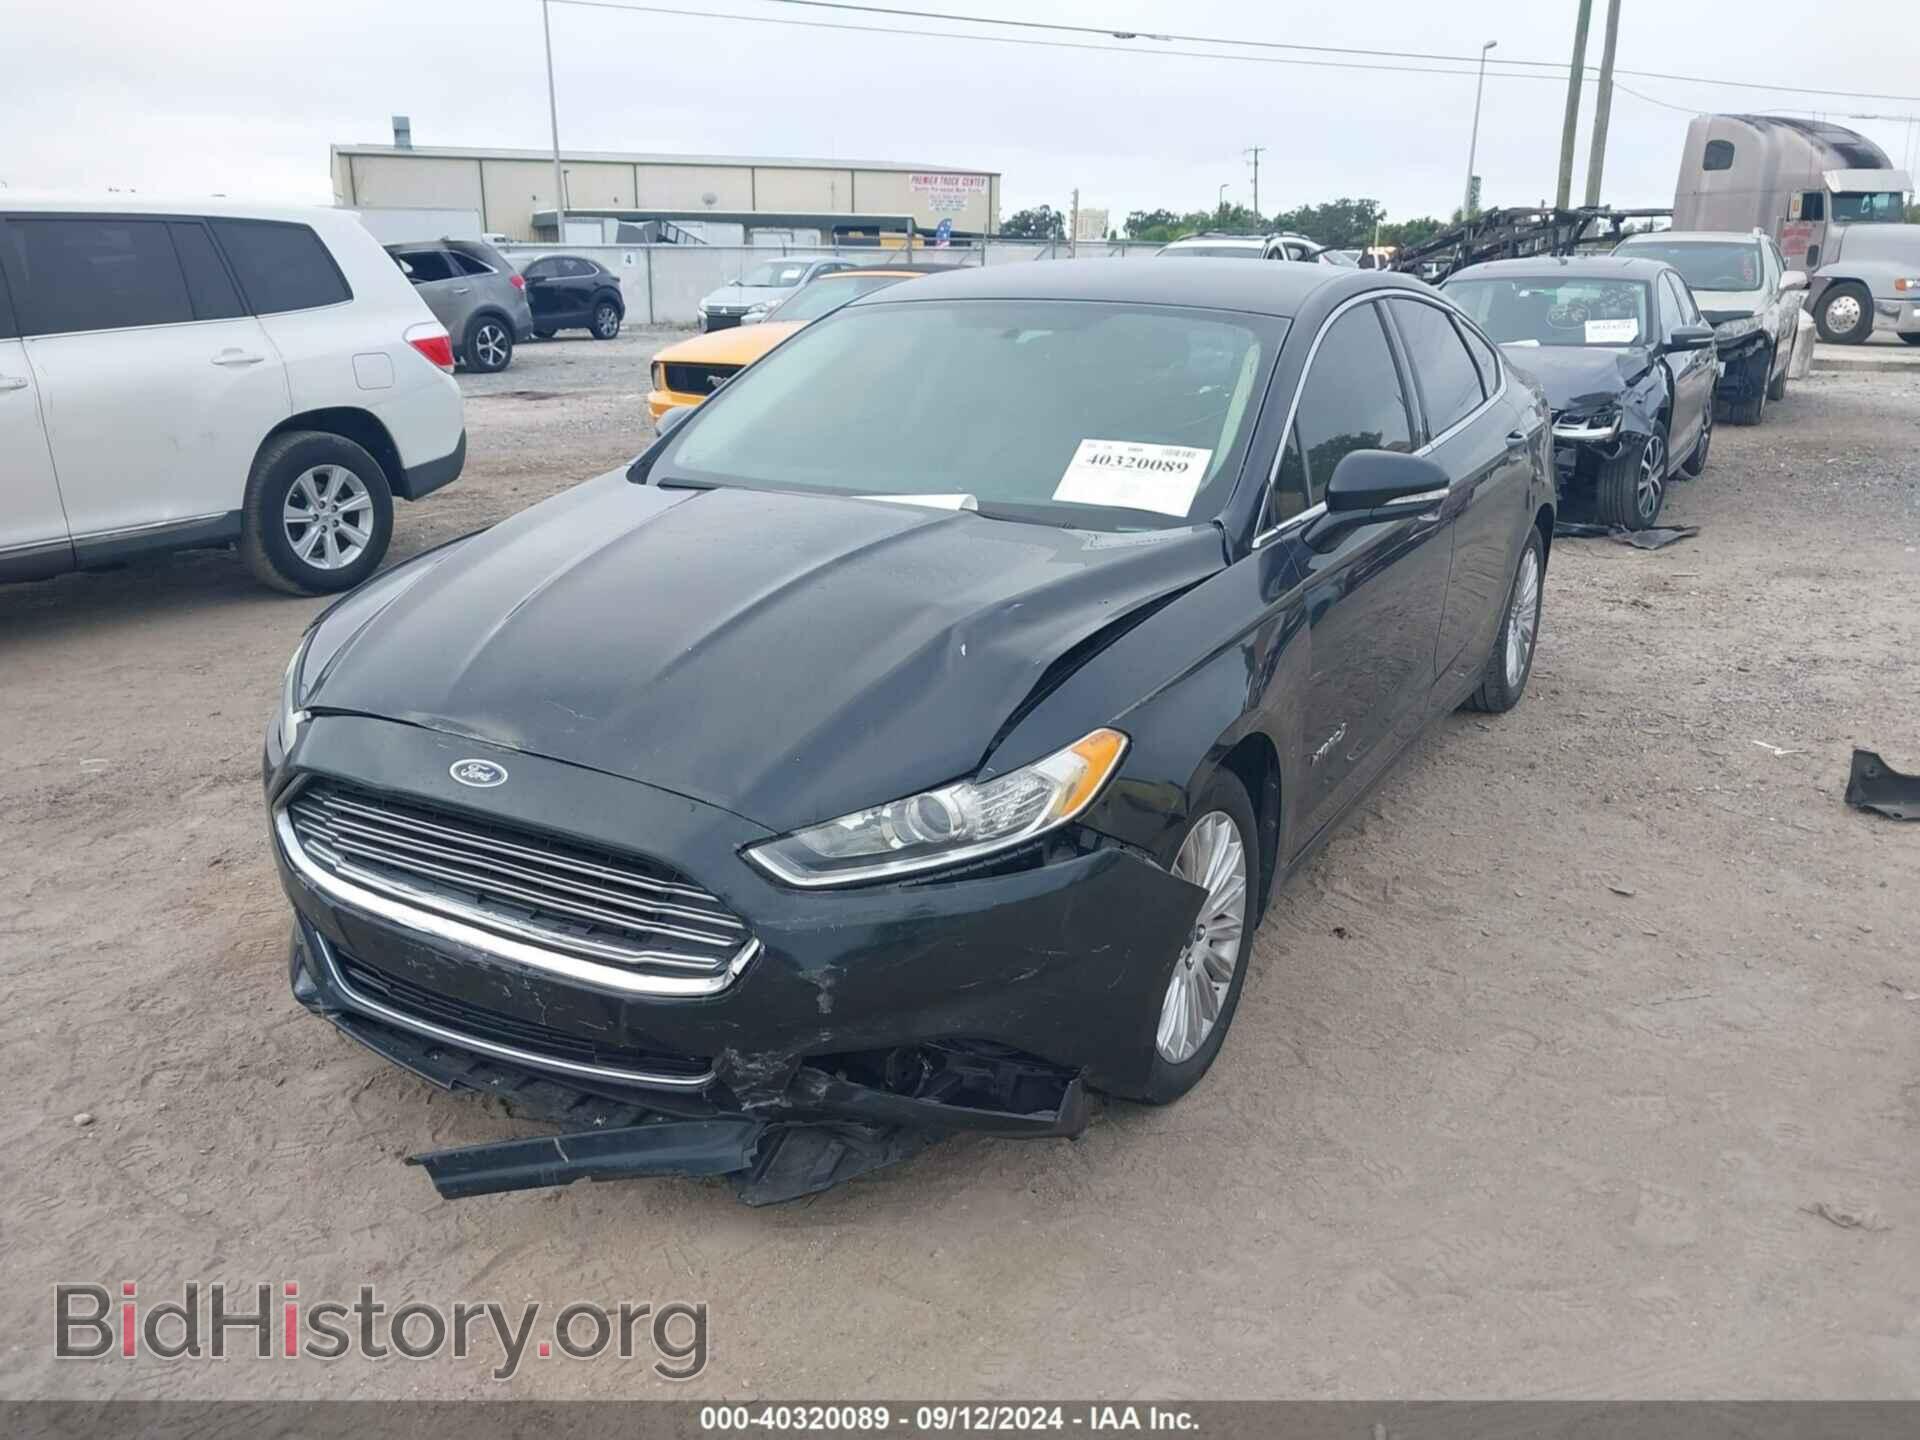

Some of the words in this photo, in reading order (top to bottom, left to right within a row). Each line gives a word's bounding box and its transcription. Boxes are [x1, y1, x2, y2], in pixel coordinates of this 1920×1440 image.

[911, 175, 938, 186] PREMIER
[940, 176, 960, 187] TRUCK
[961, 176, 986, 188] CENTER
[625, 254, 632, 265] 4
[1086, 453, 1190, 474] 40320089
